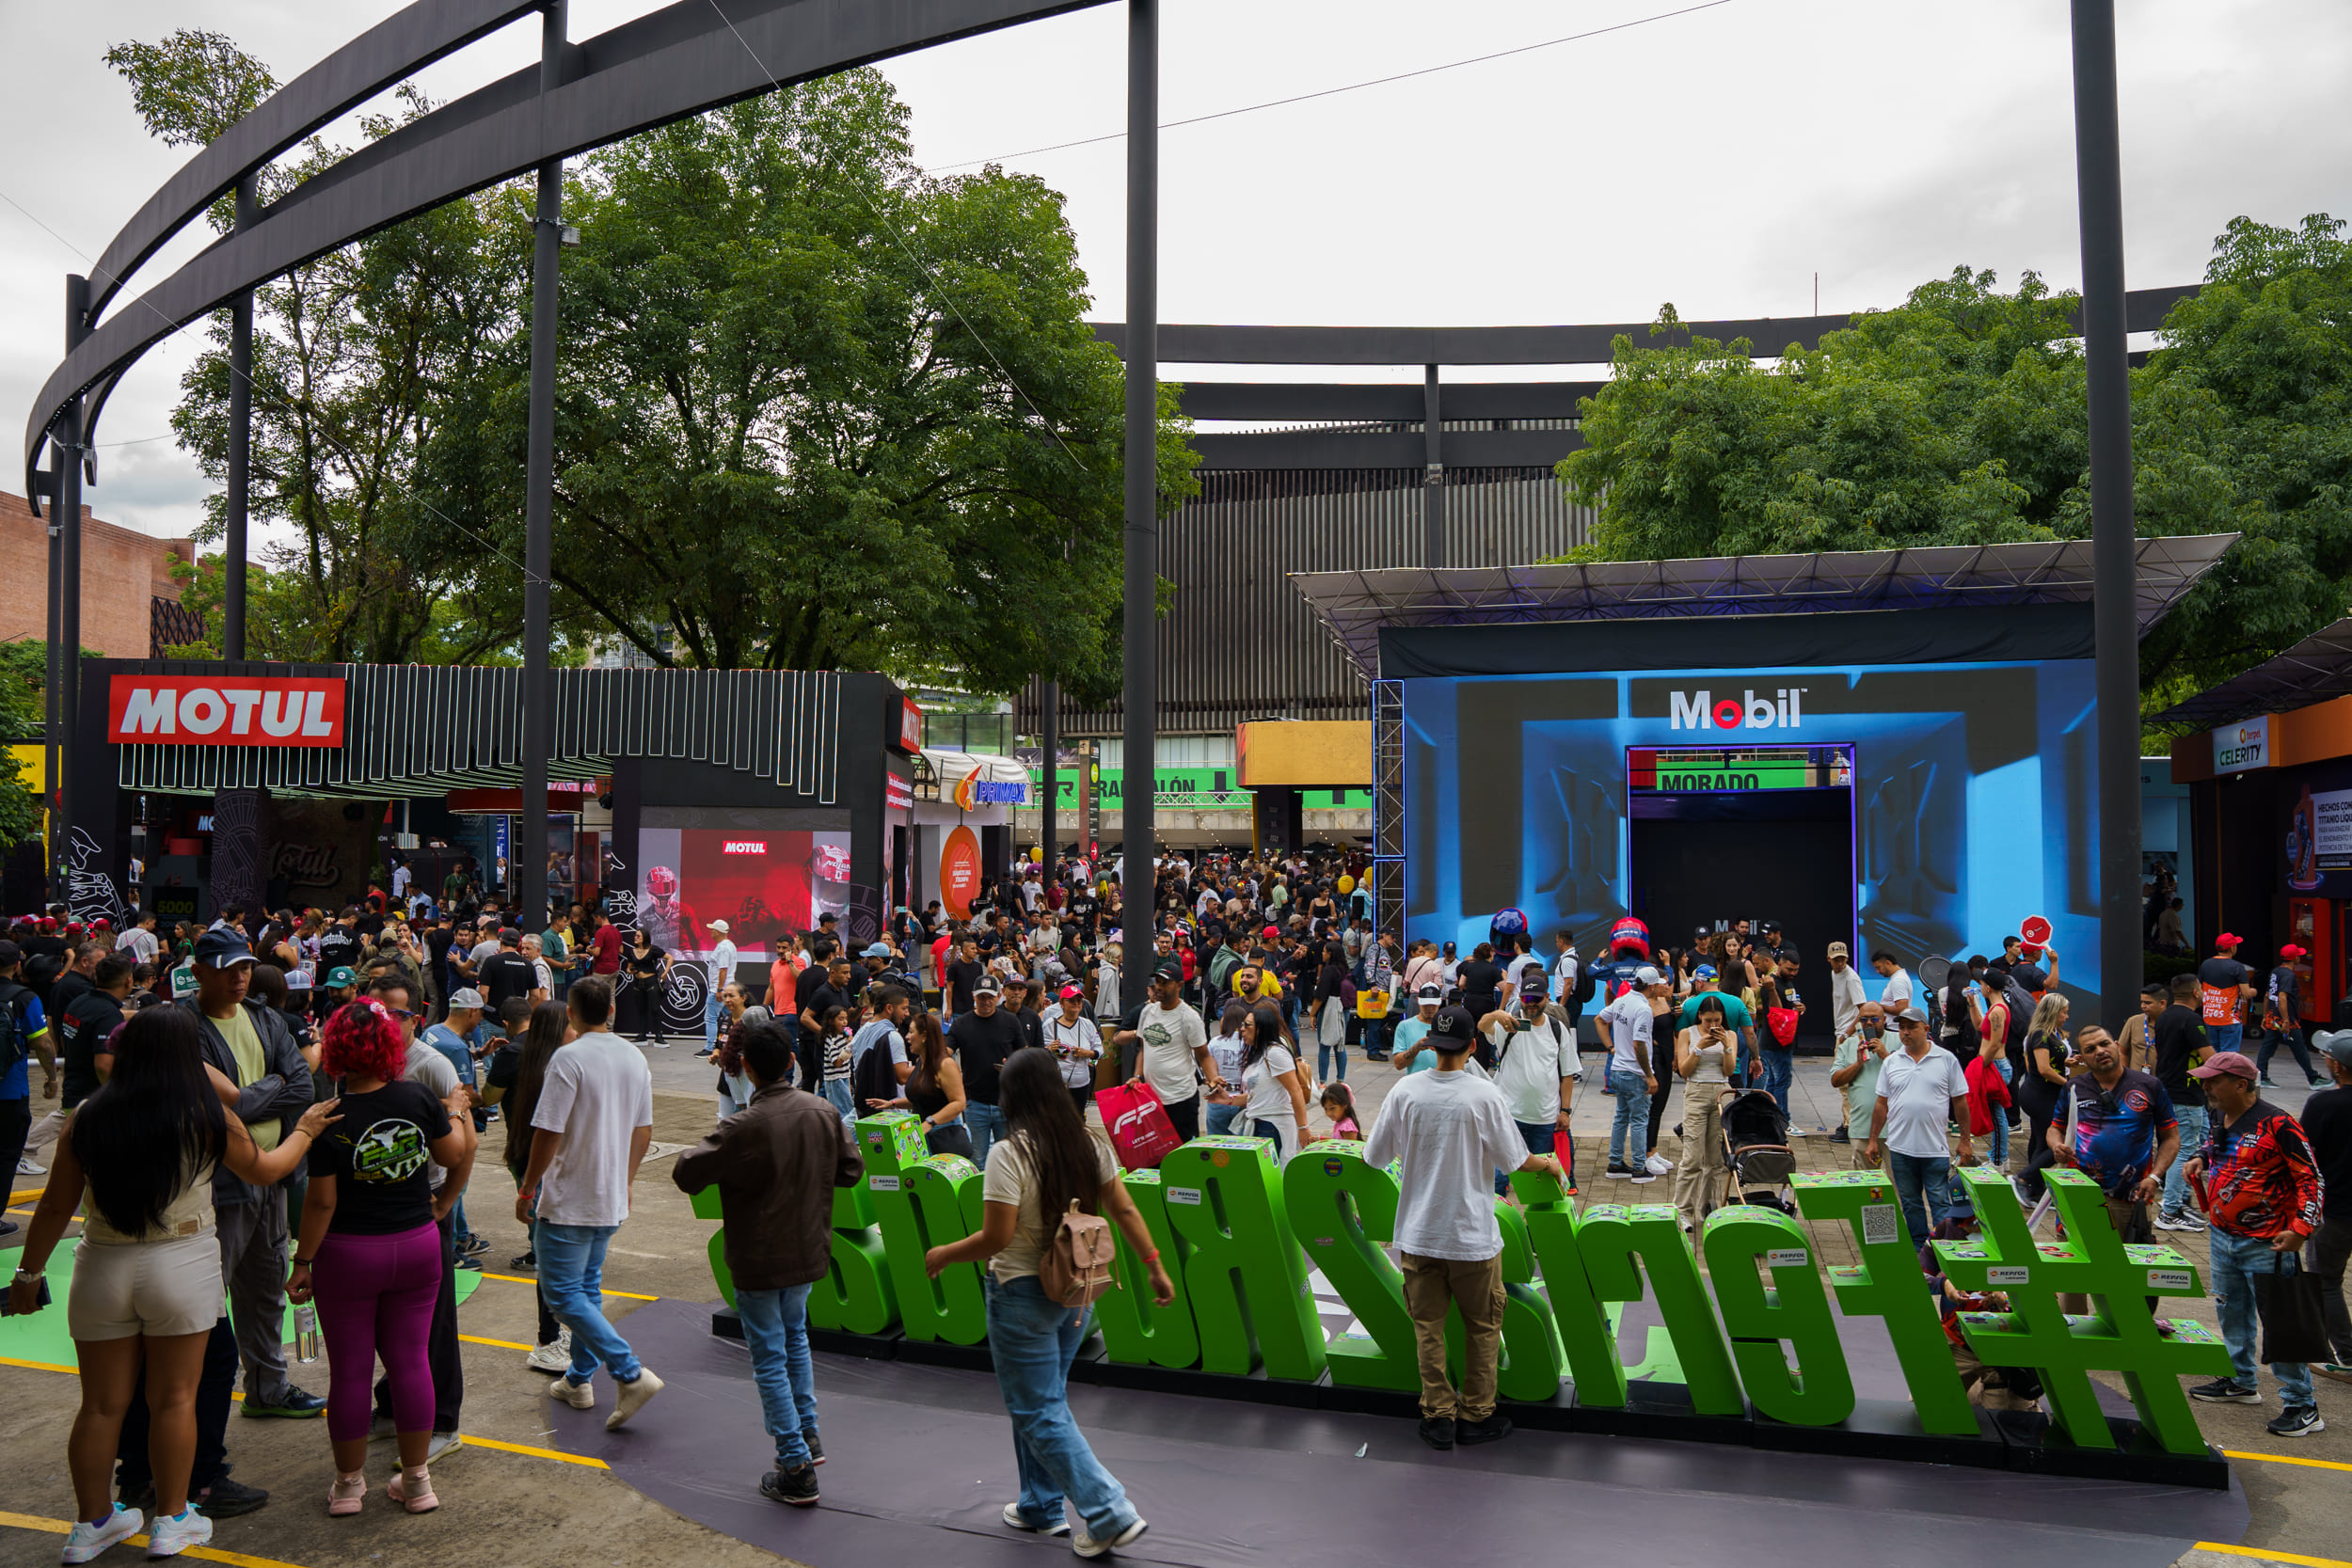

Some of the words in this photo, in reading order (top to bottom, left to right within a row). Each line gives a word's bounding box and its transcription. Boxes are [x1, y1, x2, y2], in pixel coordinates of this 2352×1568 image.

[119, 688, 334, 737] MOTUL
[1670, 688, 1801, 730] Mobil
[901, 706, 920, 747] MOTUL
[2247, 728, 2262, 742] terpel
[2219, 743, 2262, 767] CELERITY
[1661, 773, 1759, 791] MORADO
[976, 780, 1026, 803] PRIMAX
[2317, 802, 2340, 814] HECHOS
[2317, 815, 2340, 825] TITANIO
[723, 842, 766, 854] MOTUL
[157, 899, 195, 914] 5000
